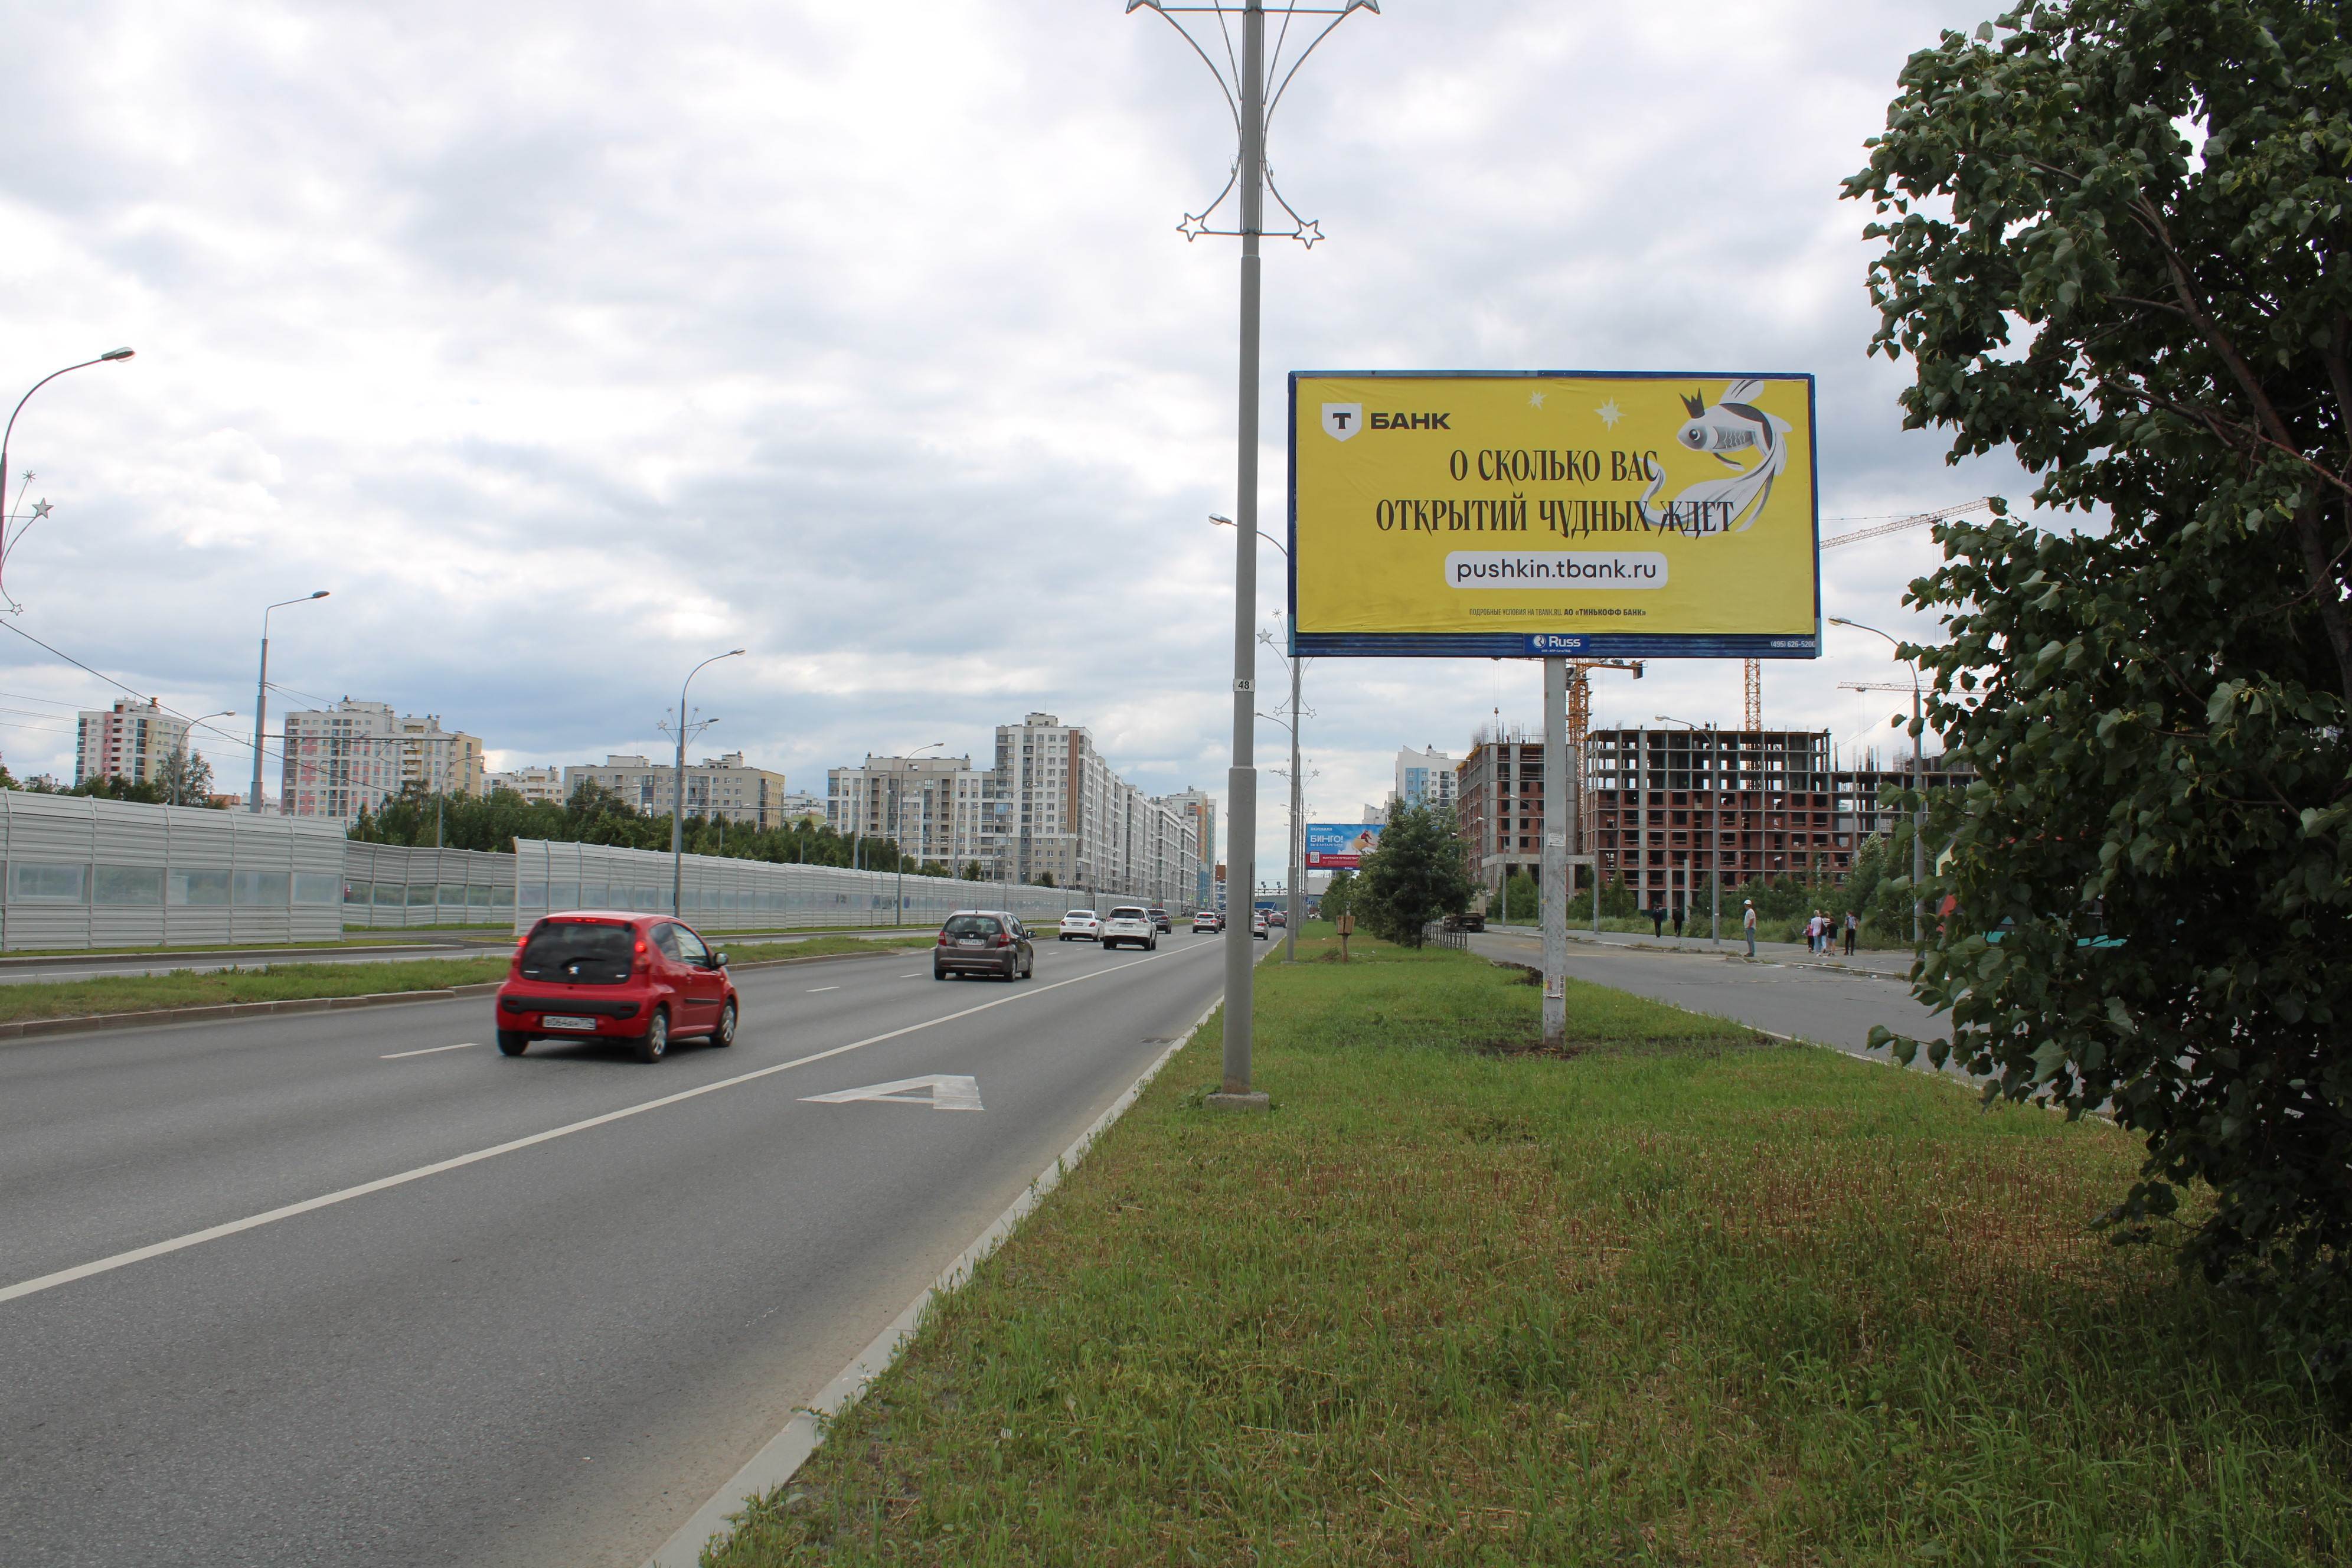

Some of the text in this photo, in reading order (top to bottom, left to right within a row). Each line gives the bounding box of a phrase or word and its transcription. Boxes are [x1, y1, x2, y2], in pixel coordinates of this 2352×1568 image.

[1332, 413, 1451, 430] Т БАНК
[1449, 449, 1660, 486] О СКОЛЬКО ВАС
[1376, 491, 1734, 540] ОТКРЫТИЙ ЧУДНЫХ ЖДЕТ
[1457, 558, 1657, 582] pushkin.tbank.ru
[1469, 608, 1501, 616] ПОДРОБНЫЕ
[1549, 636, 1581, 647] Russ
[1238, 681, 1250, 690] 48
[1310, 835, 1344, 843] БИНГО!
